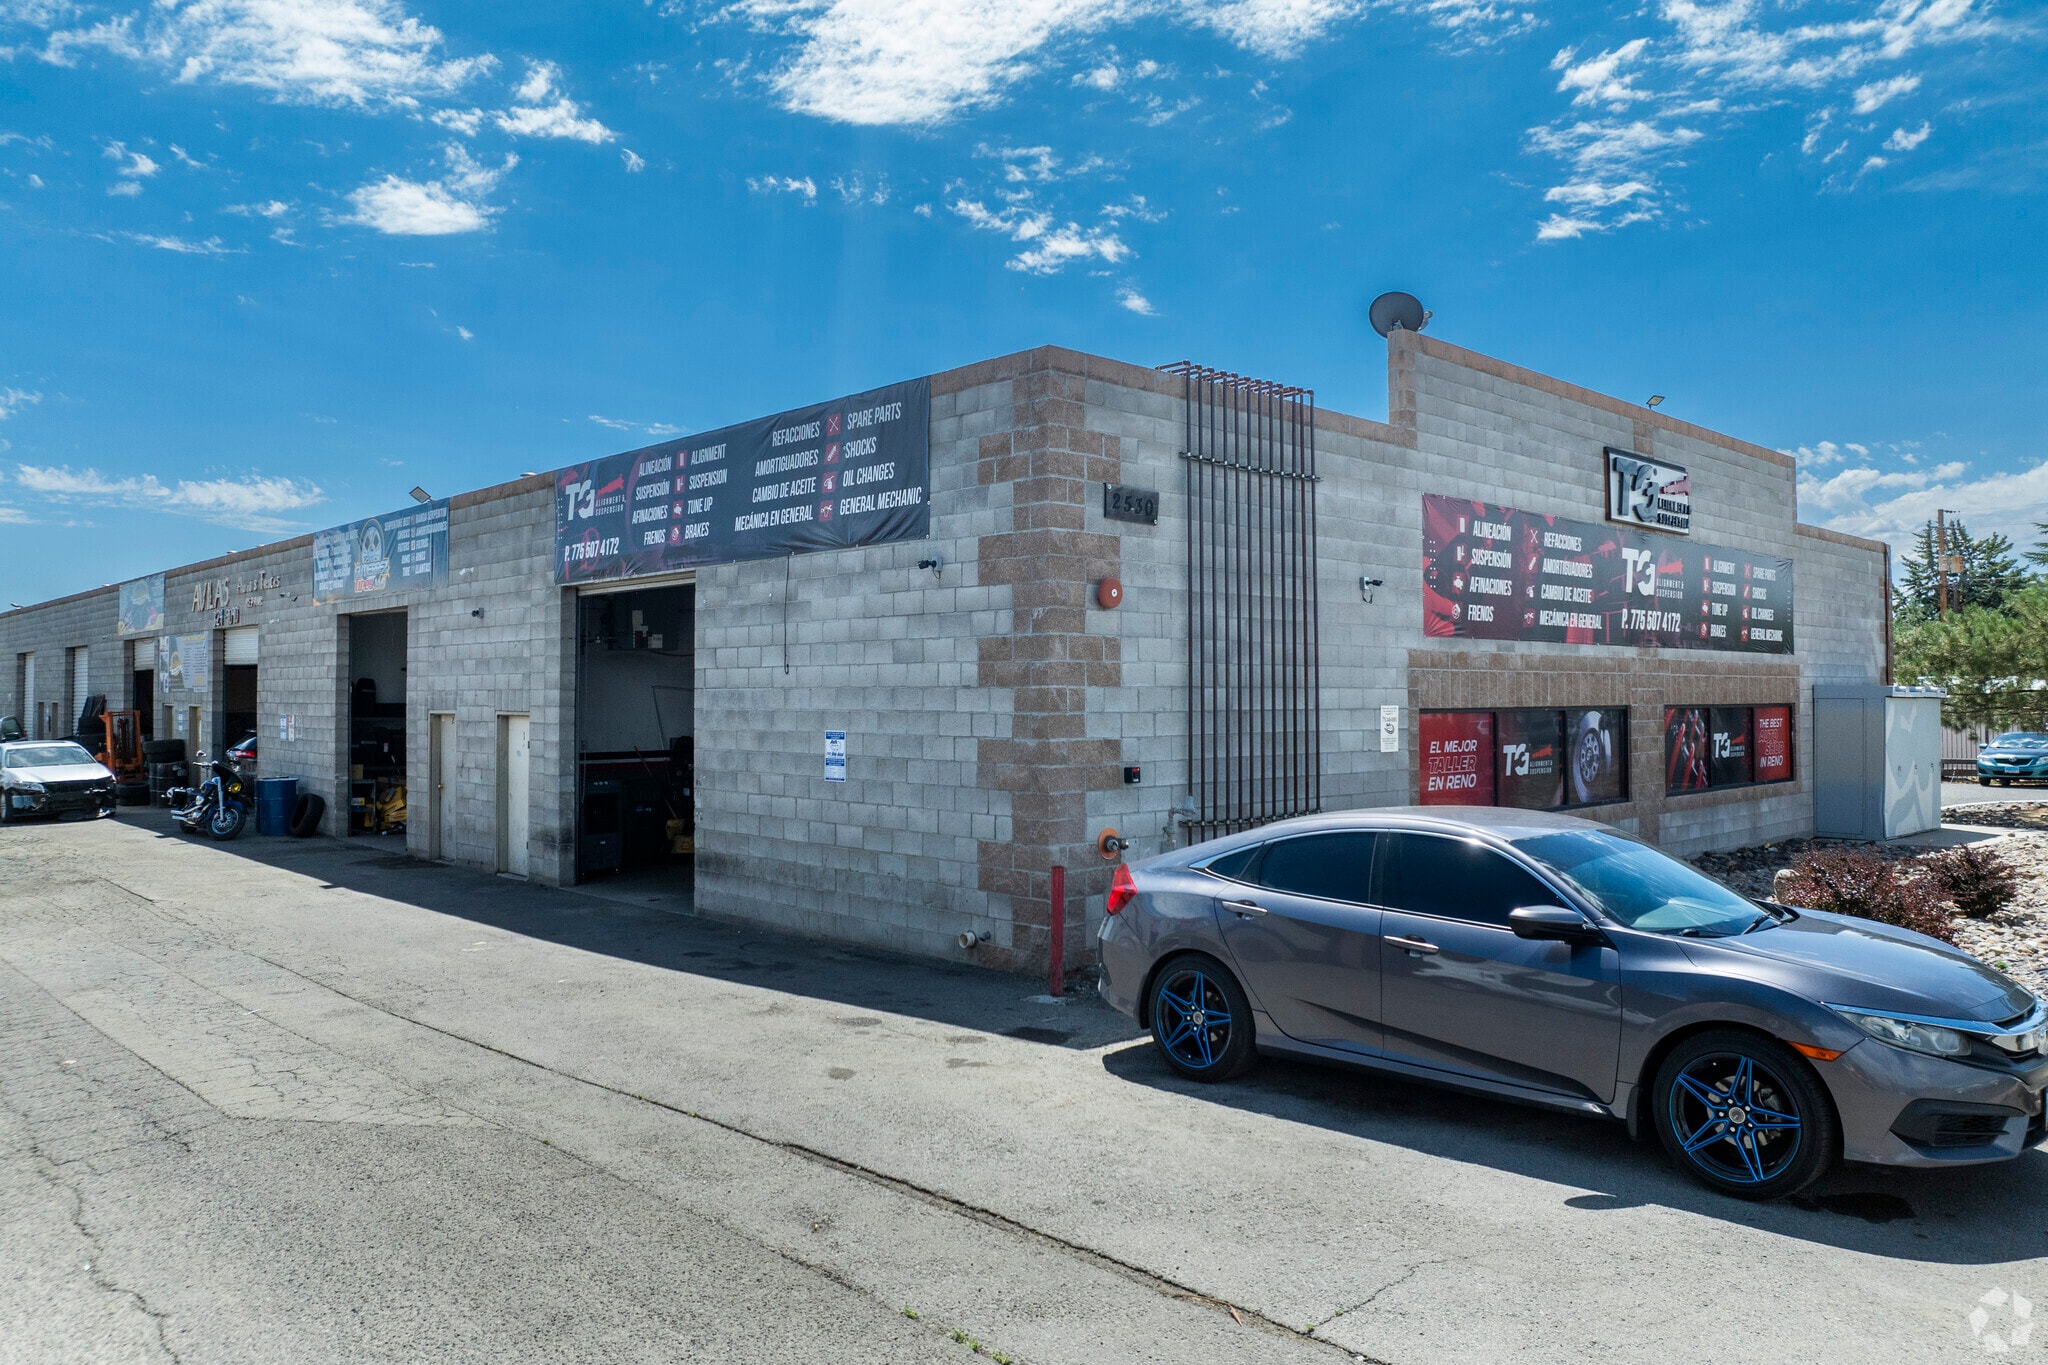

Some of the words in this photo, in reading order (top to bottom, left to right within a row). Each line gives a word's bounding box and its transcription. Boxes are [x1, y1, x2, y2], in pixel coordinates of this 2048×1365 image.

[847, 408, 872, 430] SPARE
[874, 402, 902, 423] PARTS
[772, 421, 821, 447] REFACCIONES
[690, 444, 726, 465] ALIGNMENT
[845, 436, 877, 459] SHOCKS
[638, 456, 672, 477] ALINEACIÓN
[754, 449, 819, 477] AMORTIGUADORES
[689, 469, 728, 490] SUSPENSION
[842, 470, 854, 487] OIL
[856, 462, 895, 484] CHANGES
[636, 480, 670, 501] SUSPENSIÓN
[752, 483, 778, 504] CAMBIO
[780, 482, 788, 497] DE
[789, 476, 816, 496] ACEITE
[688, 498, 702, 515] TUNE
[703, 497, 714, 512] UP
[840, 494, 876, 516] GENERAL
[877, 486, 922, 511] MECHANIC
[1112, 492, 1154, 516] 2530
[632, 504, 668, 525] AFINACIONES
[734, 511, 769, 532] MECÁNICA
[770, 510, 780, 526] EN
[780, 504, 814, 524] GENERAL
[644, 528, 666, 546] FRENOS
[684, 522, 710, 540] BRAKES
[1472, 520, 1512, 541] ALINEACIÓN
[572, 542, 584, 560] 775
[585, 540, 600, 559] 507
[600, 537, 620, 556] 4172
[1544, 532, 1582, 552] REFACCIONES
[1471, 548, 1512, 568] SUSPENSIÓN
[1542, 558, 1593, 578] AMORTIGUADORES
[1470, 576, 1512, 596] AFINACIONES
[1541, 584, 1564, 600] CAMBIO
[1564, 586, 1572, 601] DE
[1572, 587, 1592, 604] ACEITE
[1468, 604, 1494, 622] FRENOS
[1540, 608, 1569, 627] MECÁNICA
[1570, 612, 1578, 628] EN
[1578, 614, 1602, 629] GENERAL
[1622, 608, 1628, 629] P.
[1630, 609, 1646, 630] 775
[1646, 610, 1662, 630] 507
[1662, 612, 1680, 632] 4172
[1760, 718, 1770, 728] THE
[1770, 718, 1783, 728] BEST
[1430, 741, 1442, 754] EL
[1444, 740, 1478, 752] MEJOR
[1428, 755, 1477, 774] TALLER
[1760, 756, 1766, 768] IN
[1767, 755, 1784, 767] RENO
[1428, 776, 1444, 792] EN
[1446, 774, 1477, 789] RENO
